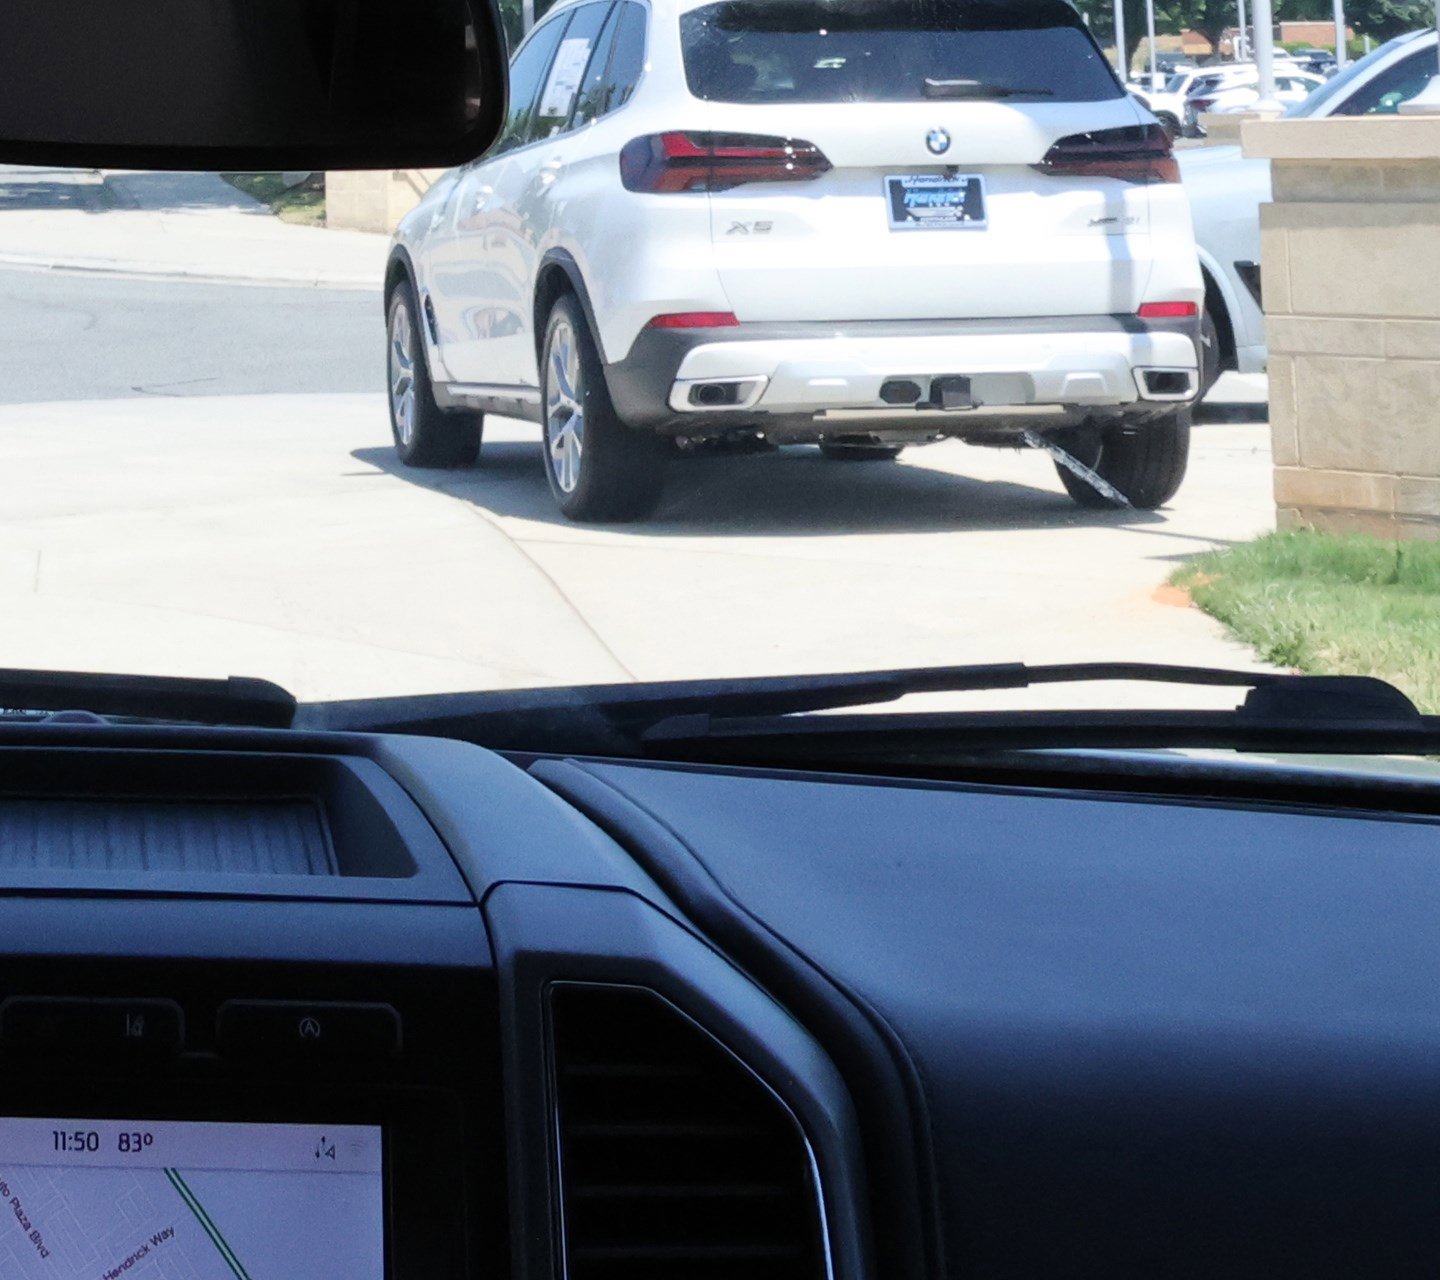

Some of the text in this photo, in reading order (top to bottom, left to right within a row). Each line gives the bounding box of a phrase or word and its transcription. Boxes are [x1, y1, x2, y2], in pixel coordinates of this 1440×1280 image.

[726, 220, 774, 235] X5
[52, 1130, 100, 1153] 11:50
[9, 1196, 31, 1232] Plaza
[29, 1229, 50, 1259] Blvd
[103, 1226, 175, 1280] Hendrick Way
